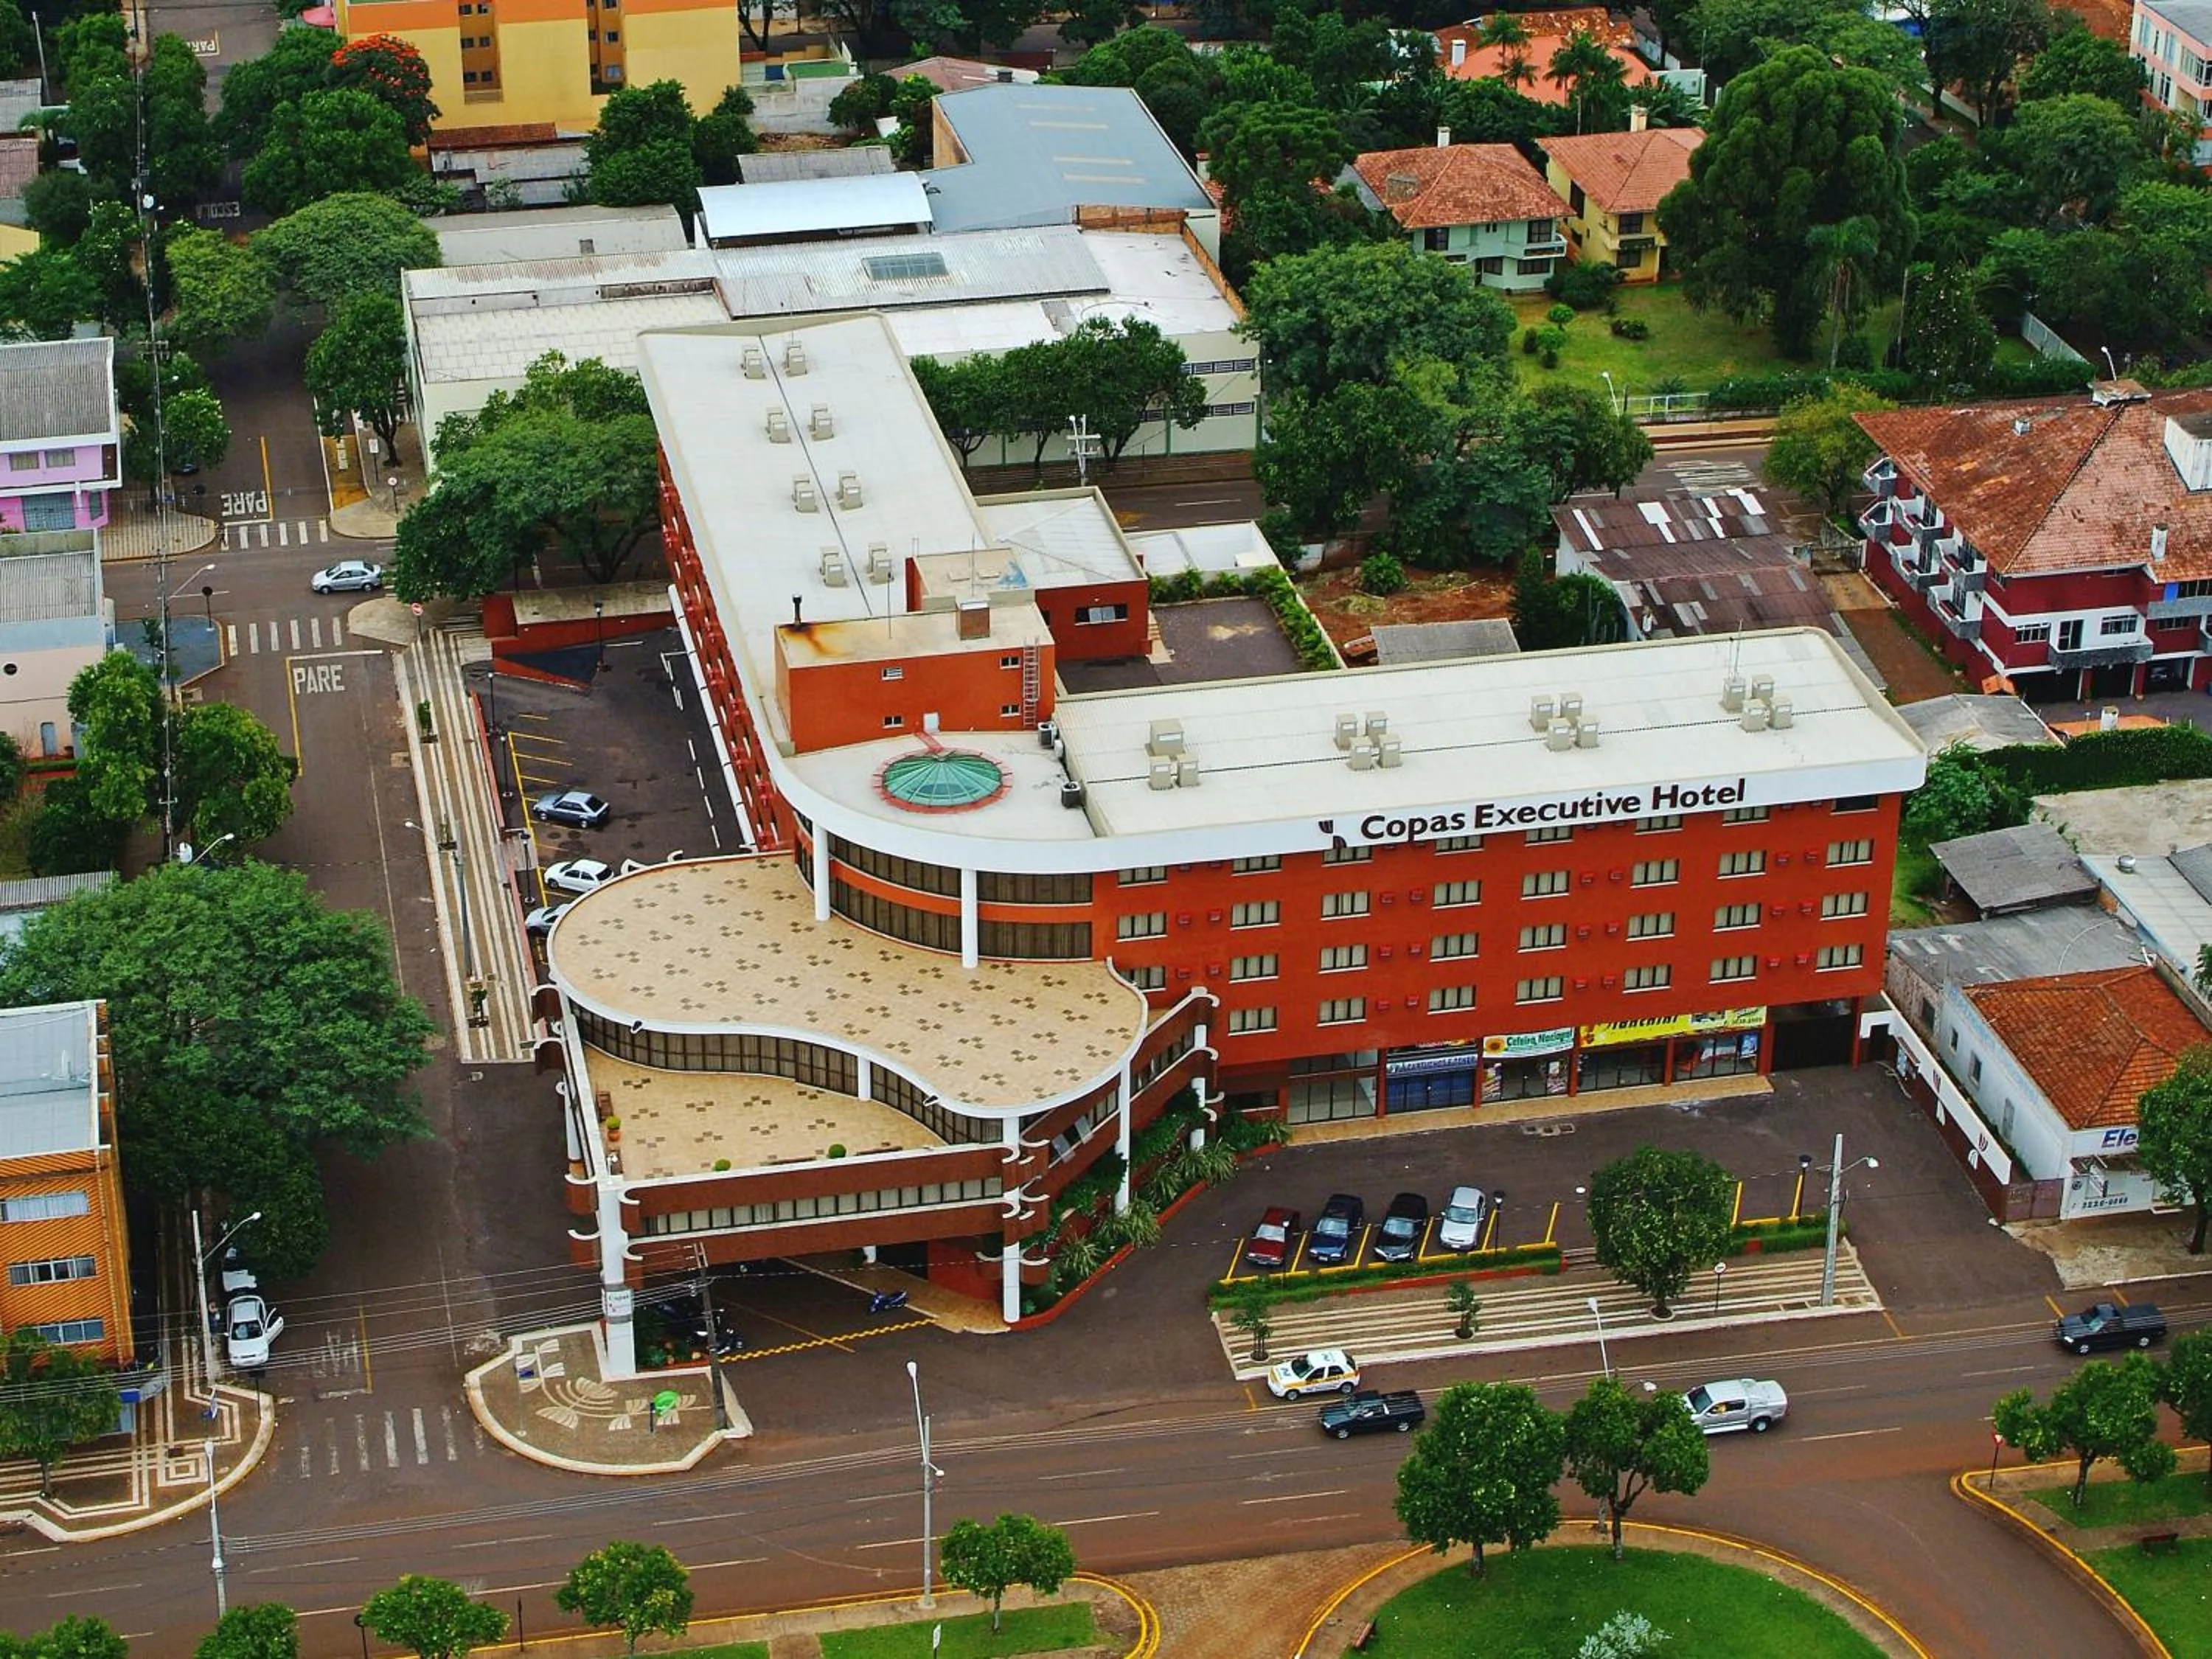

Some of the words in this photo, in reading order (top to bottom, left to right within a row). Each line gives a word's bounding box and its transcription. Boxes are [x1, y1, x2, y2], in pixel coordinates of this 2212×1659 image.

[221, 490, 268, 516] PARE
[293, 664, 345, 695] PARE
[1360, 809, 1466, 845] Copas
[1475, 791, 1641, 829] Executive
[1652, 779, 1745, 810] Hotel
